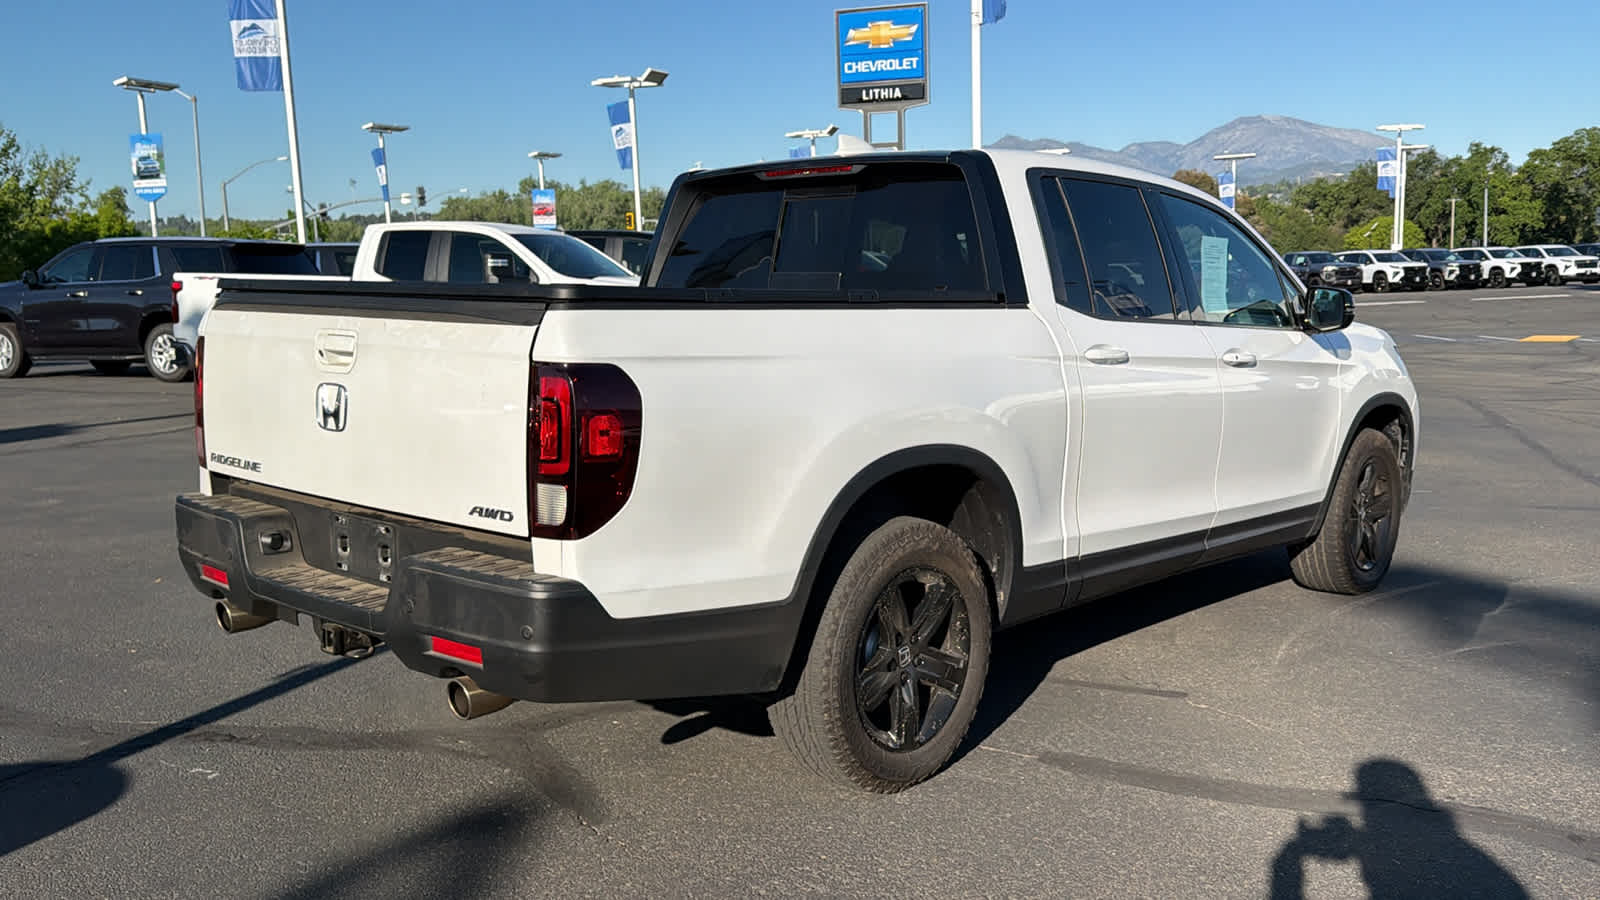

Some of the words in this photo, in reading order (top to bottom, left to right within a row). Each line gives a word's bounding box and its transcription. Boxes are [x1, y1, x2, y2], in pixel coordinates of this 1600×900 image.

[844, 57, 918, 73] CHEVROLET
[861, 87, 902, 100] LITHIA
[210, 453, 261, 473] RIDGELINE
[468, 505, 515, 523] AWD
